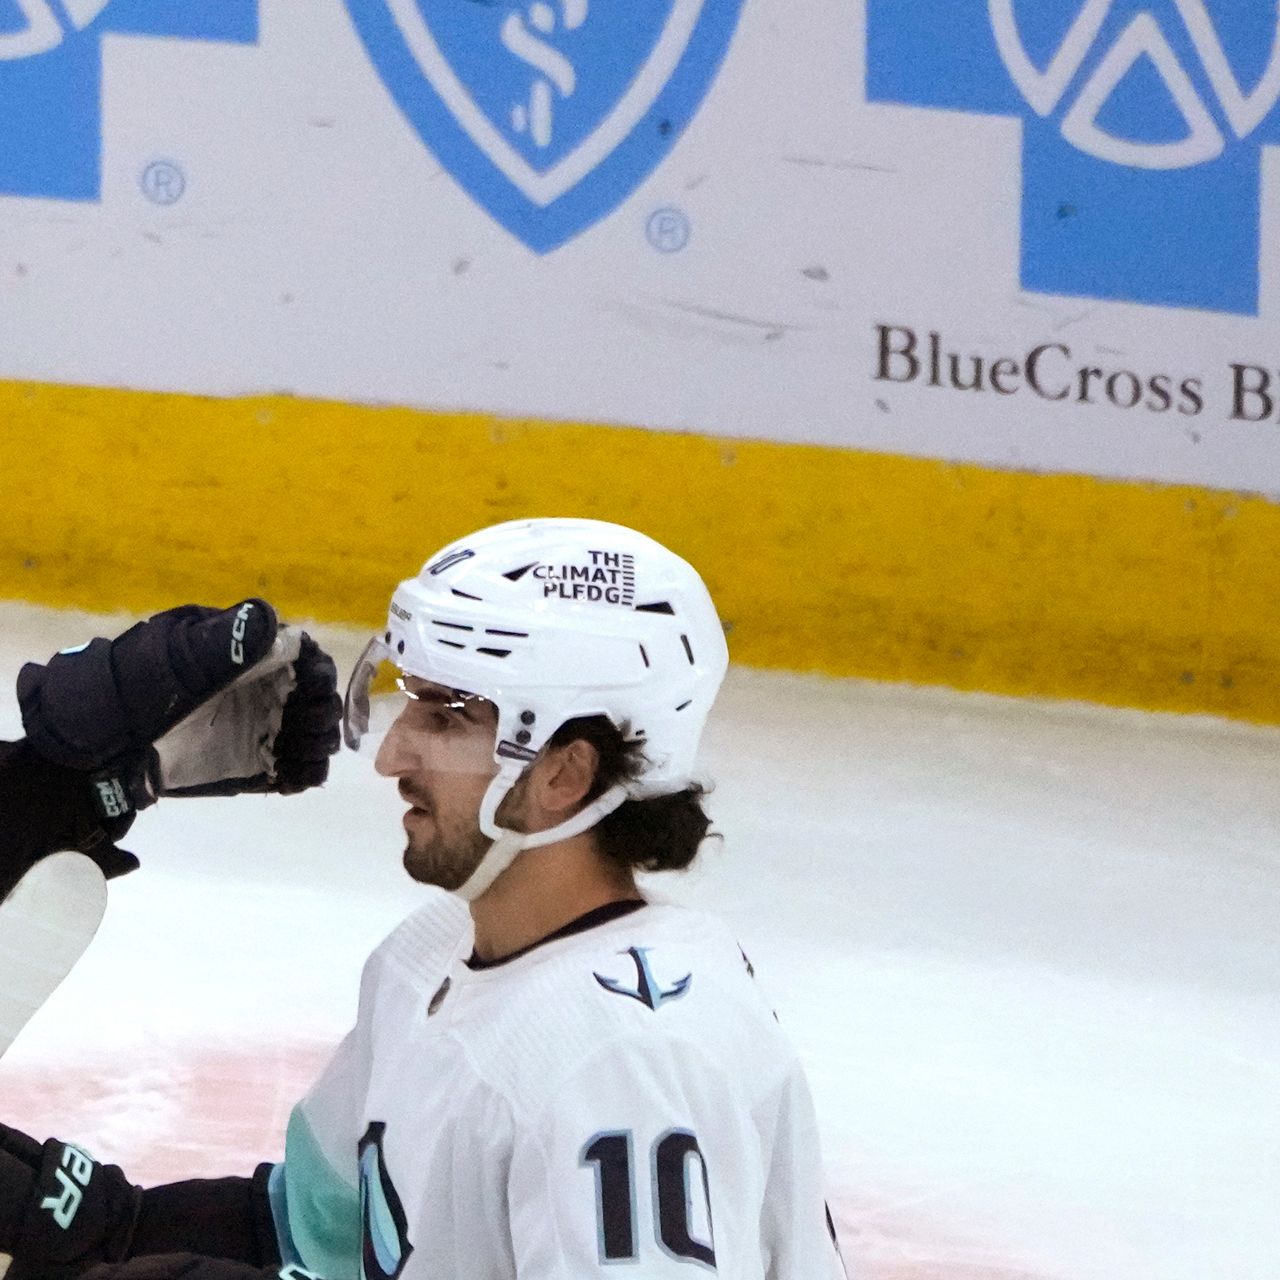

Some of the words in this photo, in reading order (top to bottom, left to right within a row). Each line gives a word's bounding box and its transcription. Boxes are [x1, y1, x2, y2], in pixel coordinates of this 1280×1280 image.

[874, 324, 1204, 416] BlueCross
[1228, 361, 1280, 424] B
[230, 602, 254, 665] CCM
[578, 1127, 719, 1277] 10
